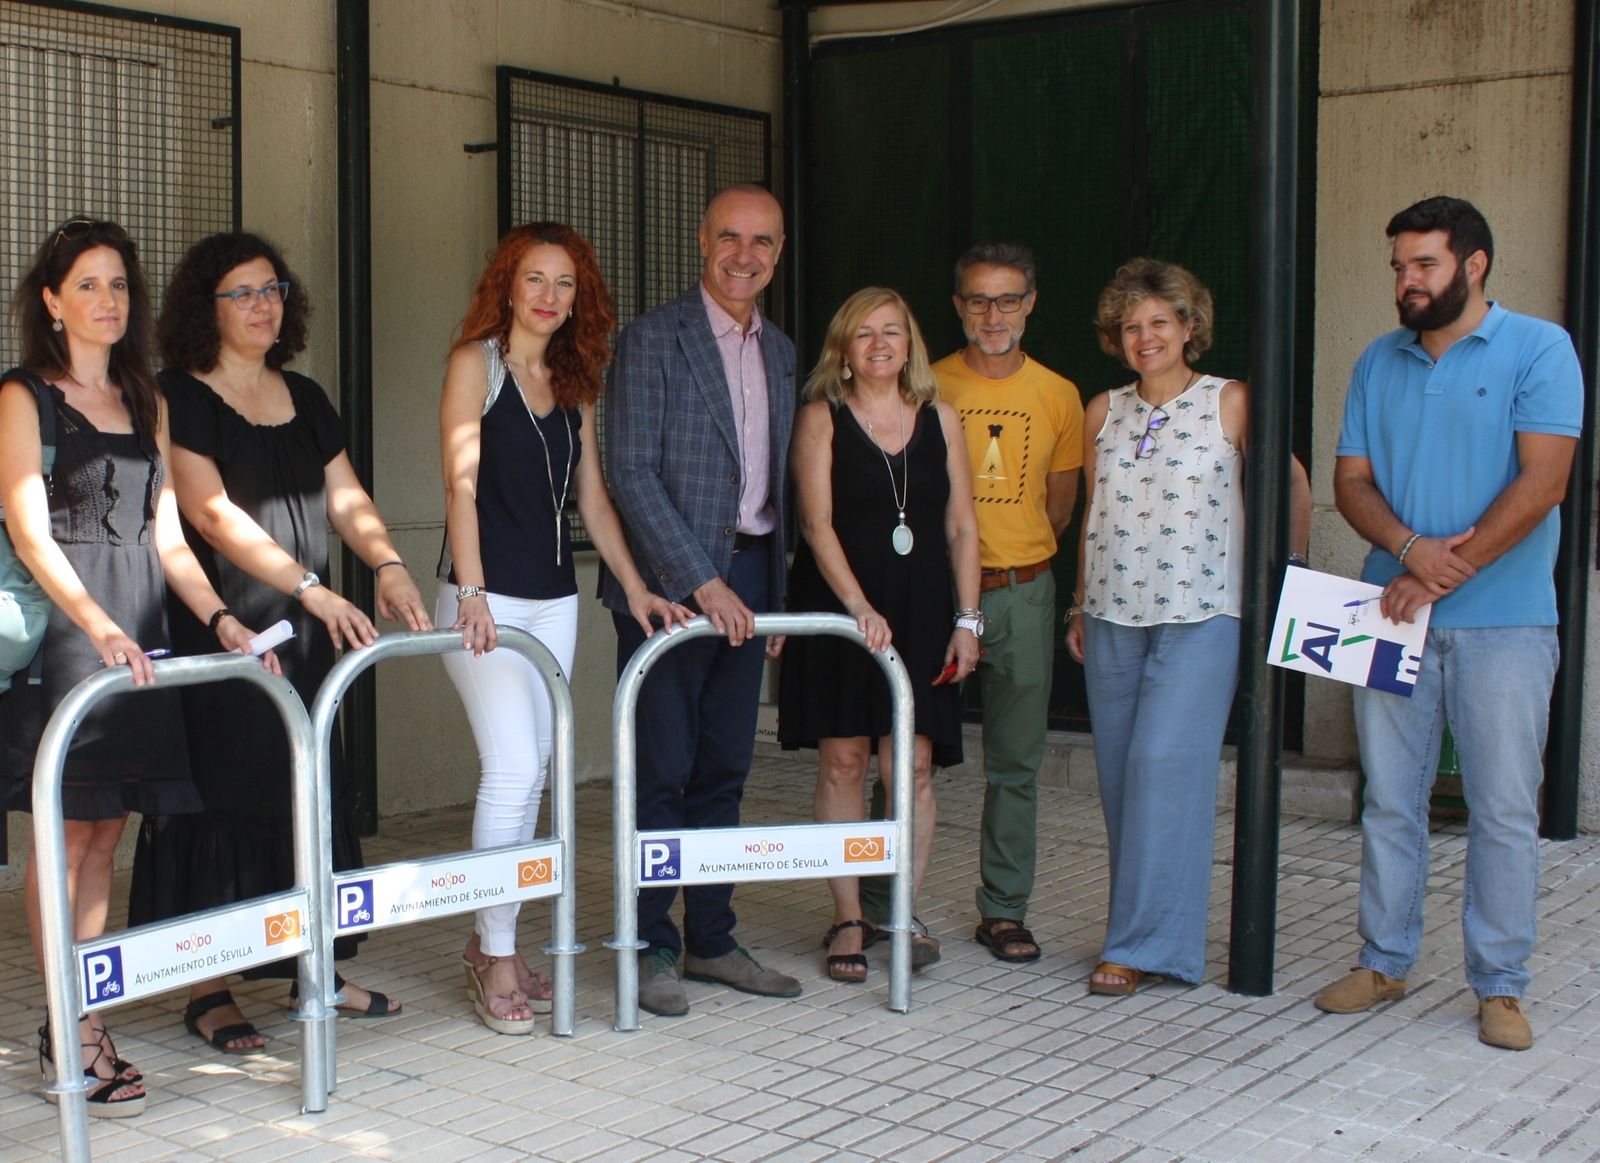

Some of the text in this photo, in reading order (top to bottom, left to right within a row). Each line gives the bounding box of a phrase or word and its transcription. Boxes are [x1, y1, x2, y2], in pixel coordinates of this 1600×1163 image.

[644, 843, 670, 878] P
[698, 857, 829, 874] AYUNTAMIENTO DE SEVILLA
[340, 886, 365, 926] P
[390, 885, 505, 915] AYUNTAMIENTO DE SEVILLA
[87, 954, 113, 1000] P
[135, 945, 253, 986] AYUNTAMIENTO DE SEVILLA
